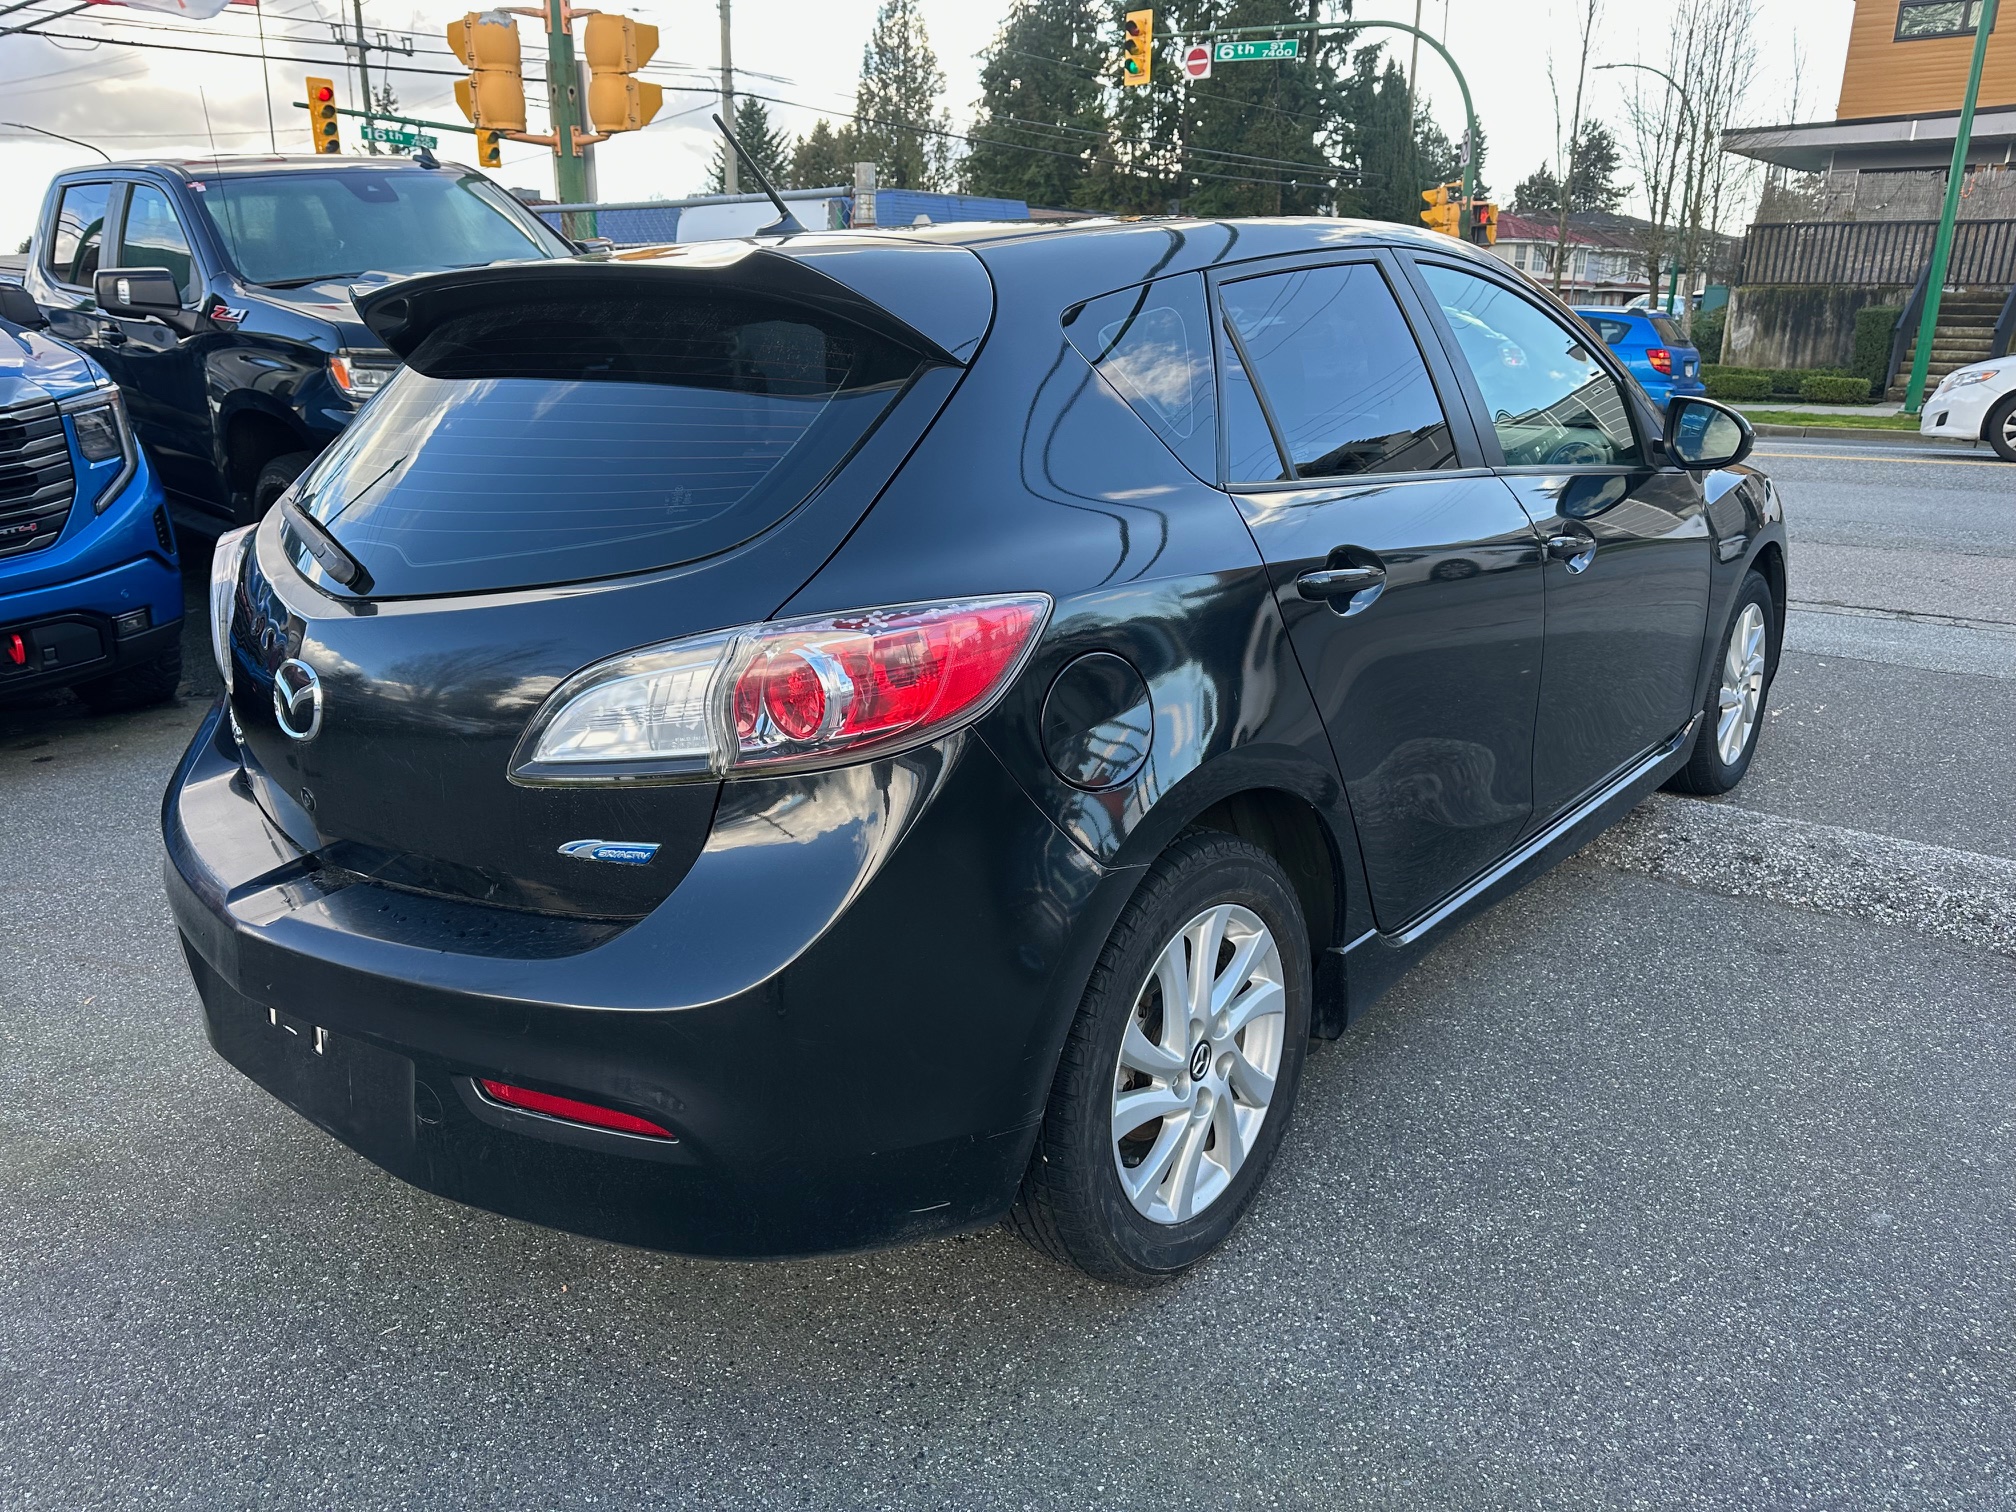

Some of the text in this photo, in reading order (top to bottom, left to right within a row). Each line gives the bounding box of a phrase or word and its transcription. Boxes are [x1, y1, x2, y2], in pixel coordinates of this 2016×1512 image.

[1220, 42, 1286, 59] 6th ST
[1262, 49, 1292, 57] 7400
[364, 128, 403, 141] 16th
